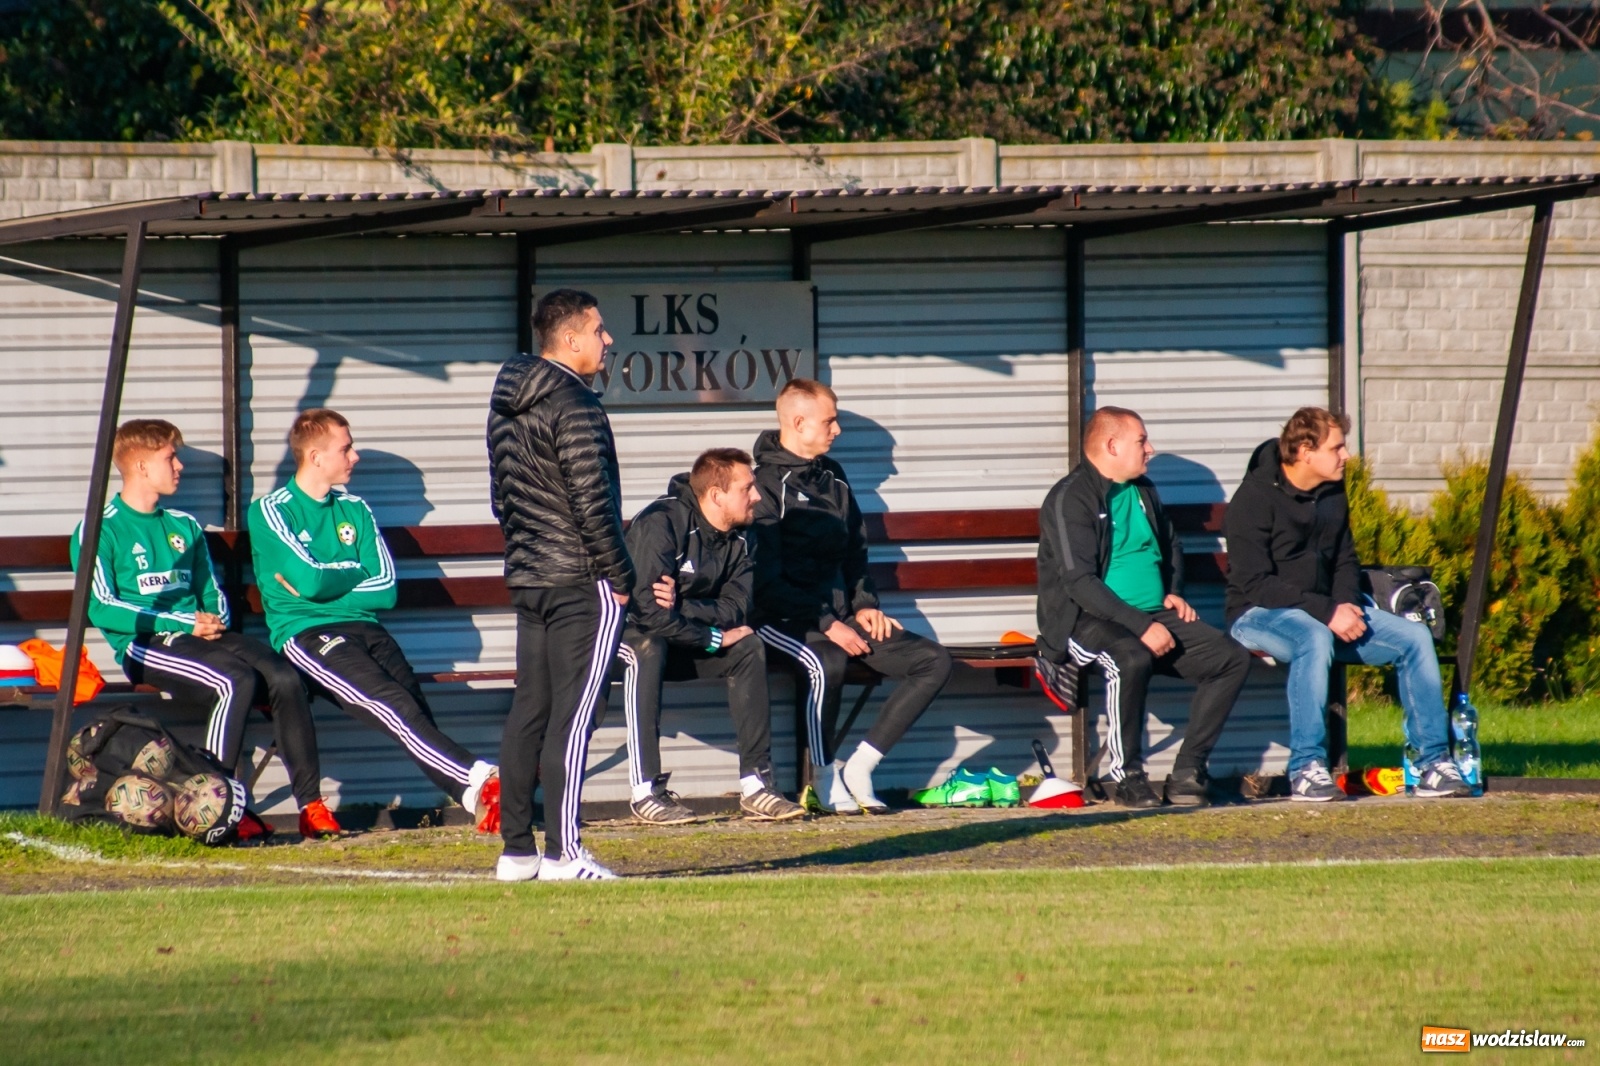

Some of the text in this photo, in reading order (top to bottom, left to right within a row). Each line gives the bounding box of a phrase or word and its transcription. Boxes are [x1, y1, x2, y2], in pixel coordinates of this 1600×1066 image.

[631, 293, 719, 335] LKS
[588, 334, 802, 393] WORKÓW
[135, 555, 149, 570] 15
